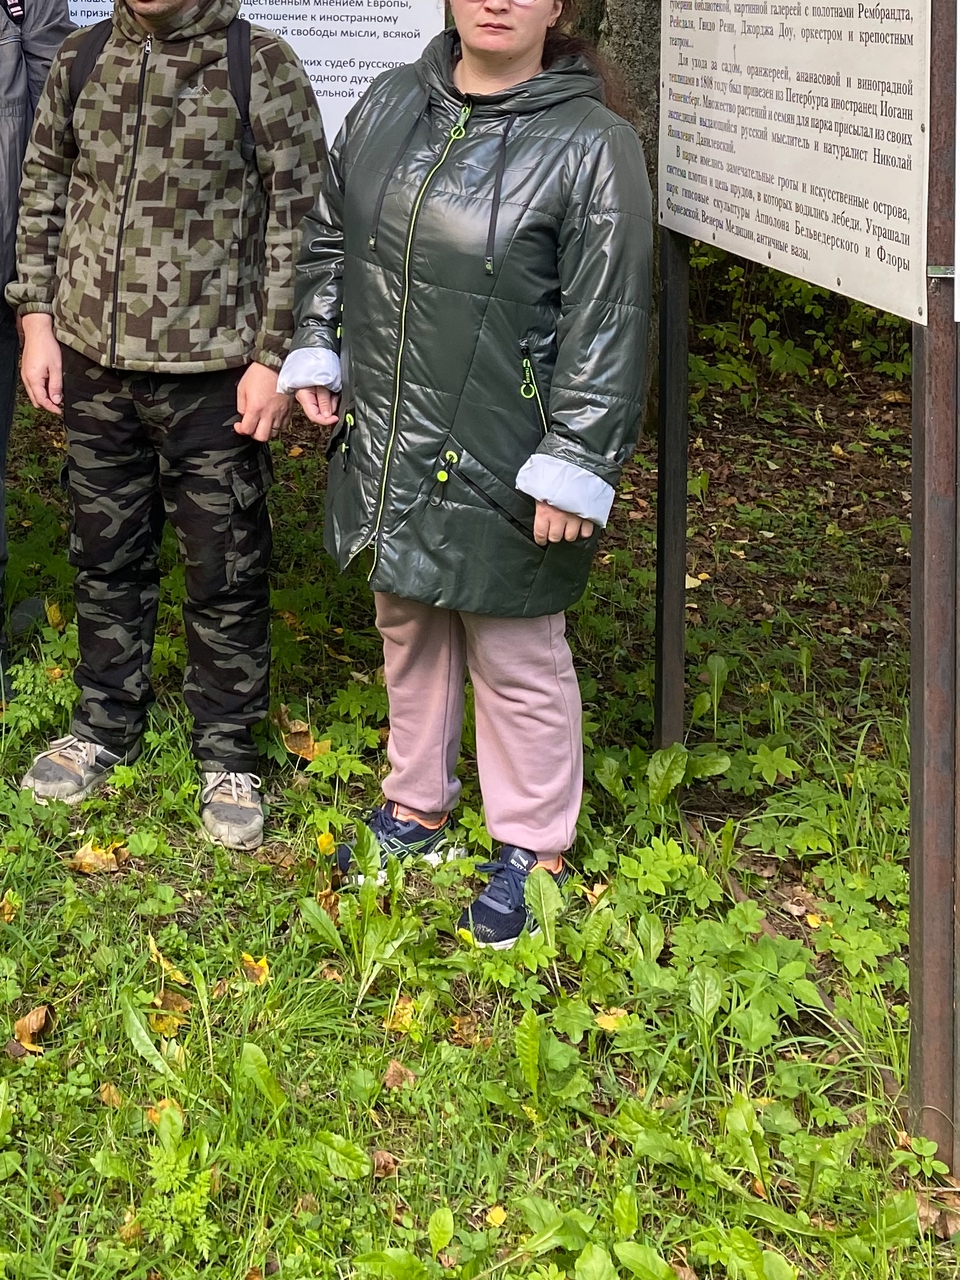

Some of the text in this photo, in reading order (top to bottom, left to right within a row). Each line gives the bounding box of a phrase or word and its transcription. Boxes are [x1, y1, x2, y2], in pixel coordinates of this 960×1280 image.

[811, 1, 915, 25] полотнами Рембрандта,
[799, 27, 915, 48] оркестром крепостным
[856, 77, 914, 97] виноградной
[784, 86, 914, 122] Петербурга иностранец Иоганн
[822, 141, 913, 172] натуралист Николай
[809, 183, 911, 226] искусственные острова,
[830, 209, 911, 247] лебеди. Украшали
[794, 219, 911, 274] Бельведерского Флоры
